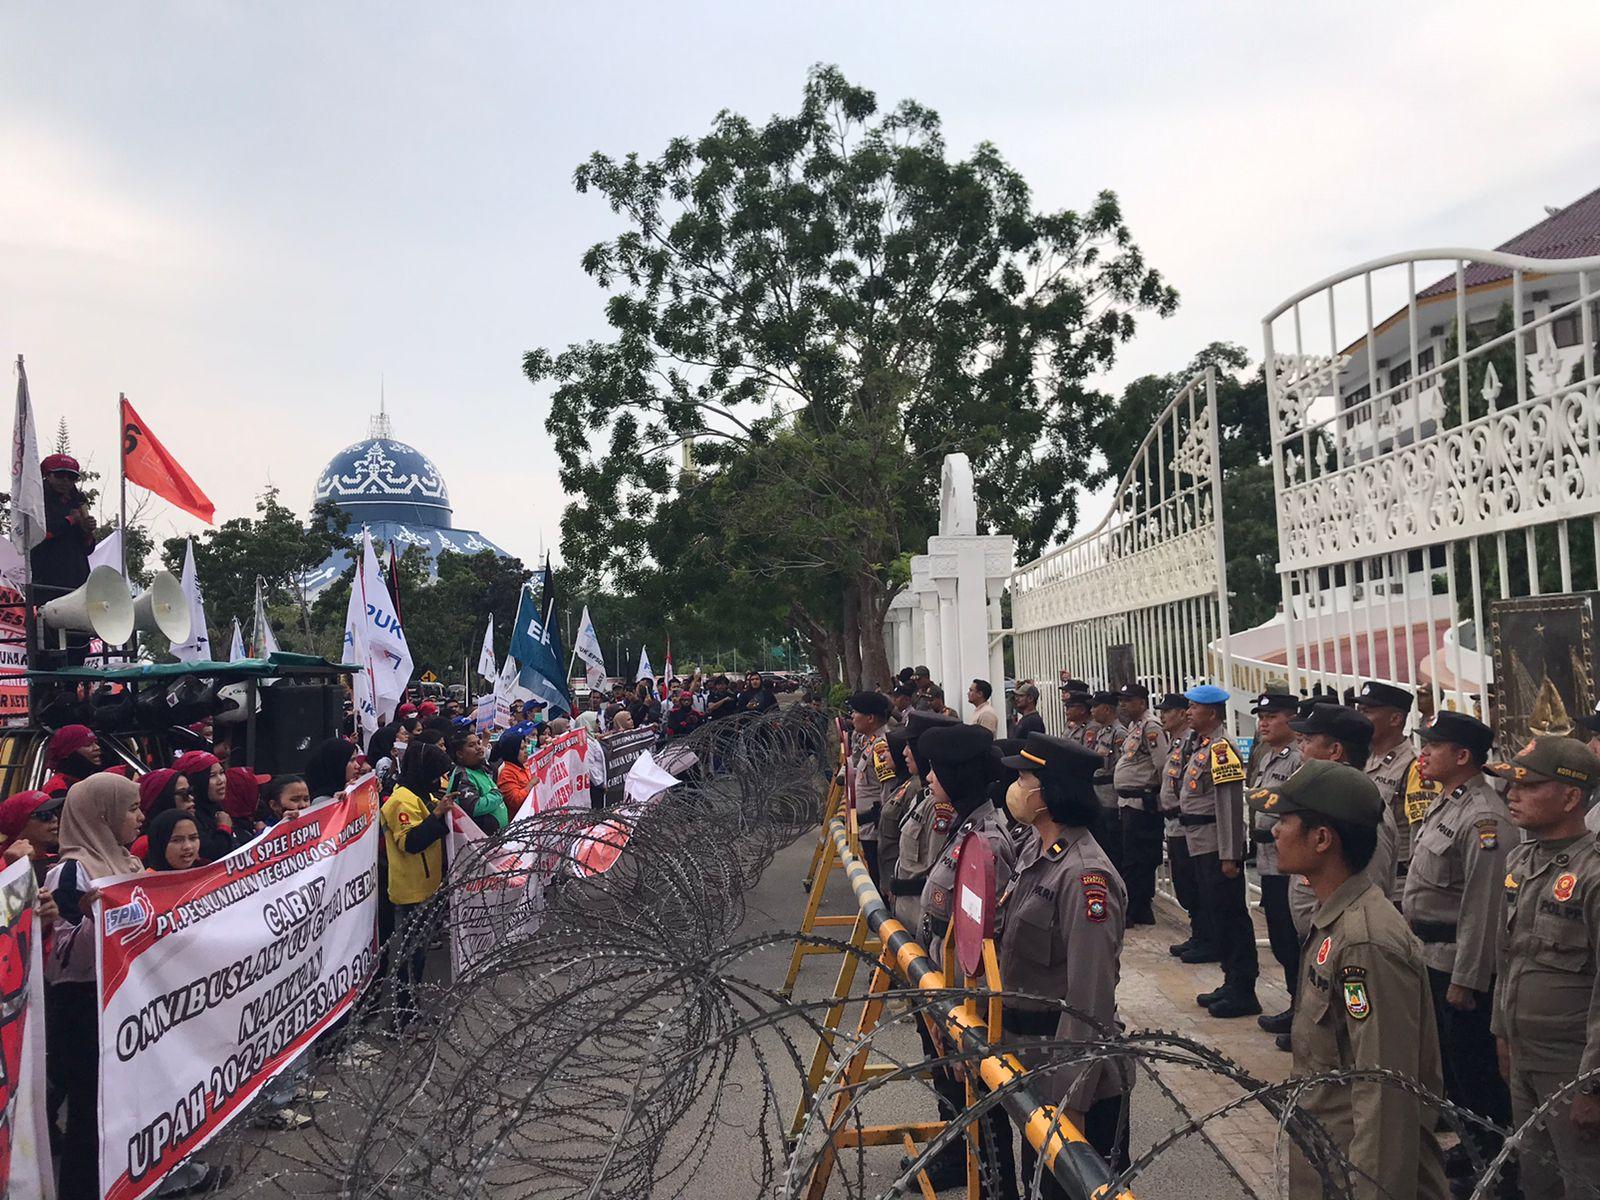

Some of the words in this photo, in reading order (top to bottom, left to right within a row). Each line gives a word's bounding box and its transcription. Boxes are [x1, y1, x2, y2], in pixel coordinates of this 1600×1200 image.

[225, 850, 255, 875] PUK
[258, 834, 289, 862] SPEE
[290, 820, 321, 848] FSPMI
[259, 837, 338, 887] TECHNOLOGY
[263, 876, 325, 936] CABUT
[127, 1080, 207, 1182] UPAH
[210, 1031, 269, 1112] 2025
[270, 965, 349, 1059] SEBESAR
